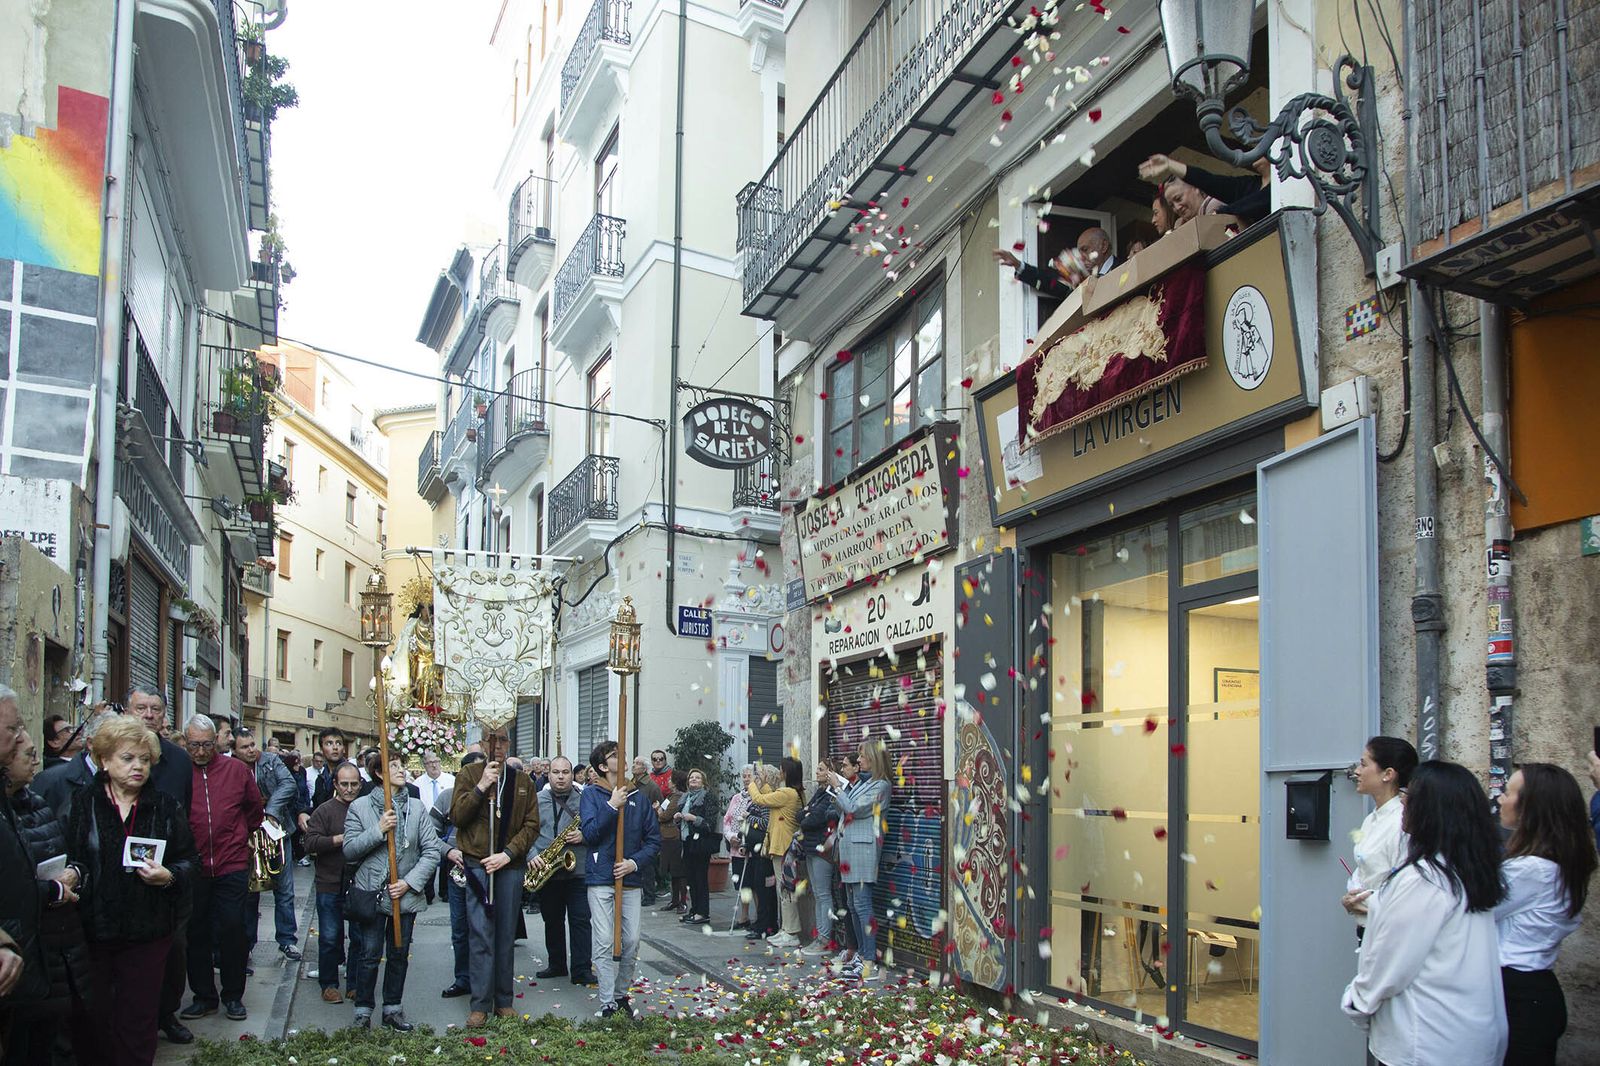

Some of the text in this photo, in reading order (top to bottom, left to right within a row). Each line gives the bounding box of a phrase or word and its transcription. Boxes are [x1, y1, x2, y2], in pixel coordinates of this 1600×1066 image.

[1073, 379, 1183, 457] LA VIRGEN
[713, 420, 750, 435] DE LA
[800, 443, 935, 540] JOSEA TIMONEDA
[862, 513, 877, 530] DE
[871, 554, 884, 568] DE
[683, 609, 708, 619] CALLE
[867, 594, 886, 624] 20
[681, 621, 709, 636] JURISTAS
[829, 628, 880, 655] REPARACION
